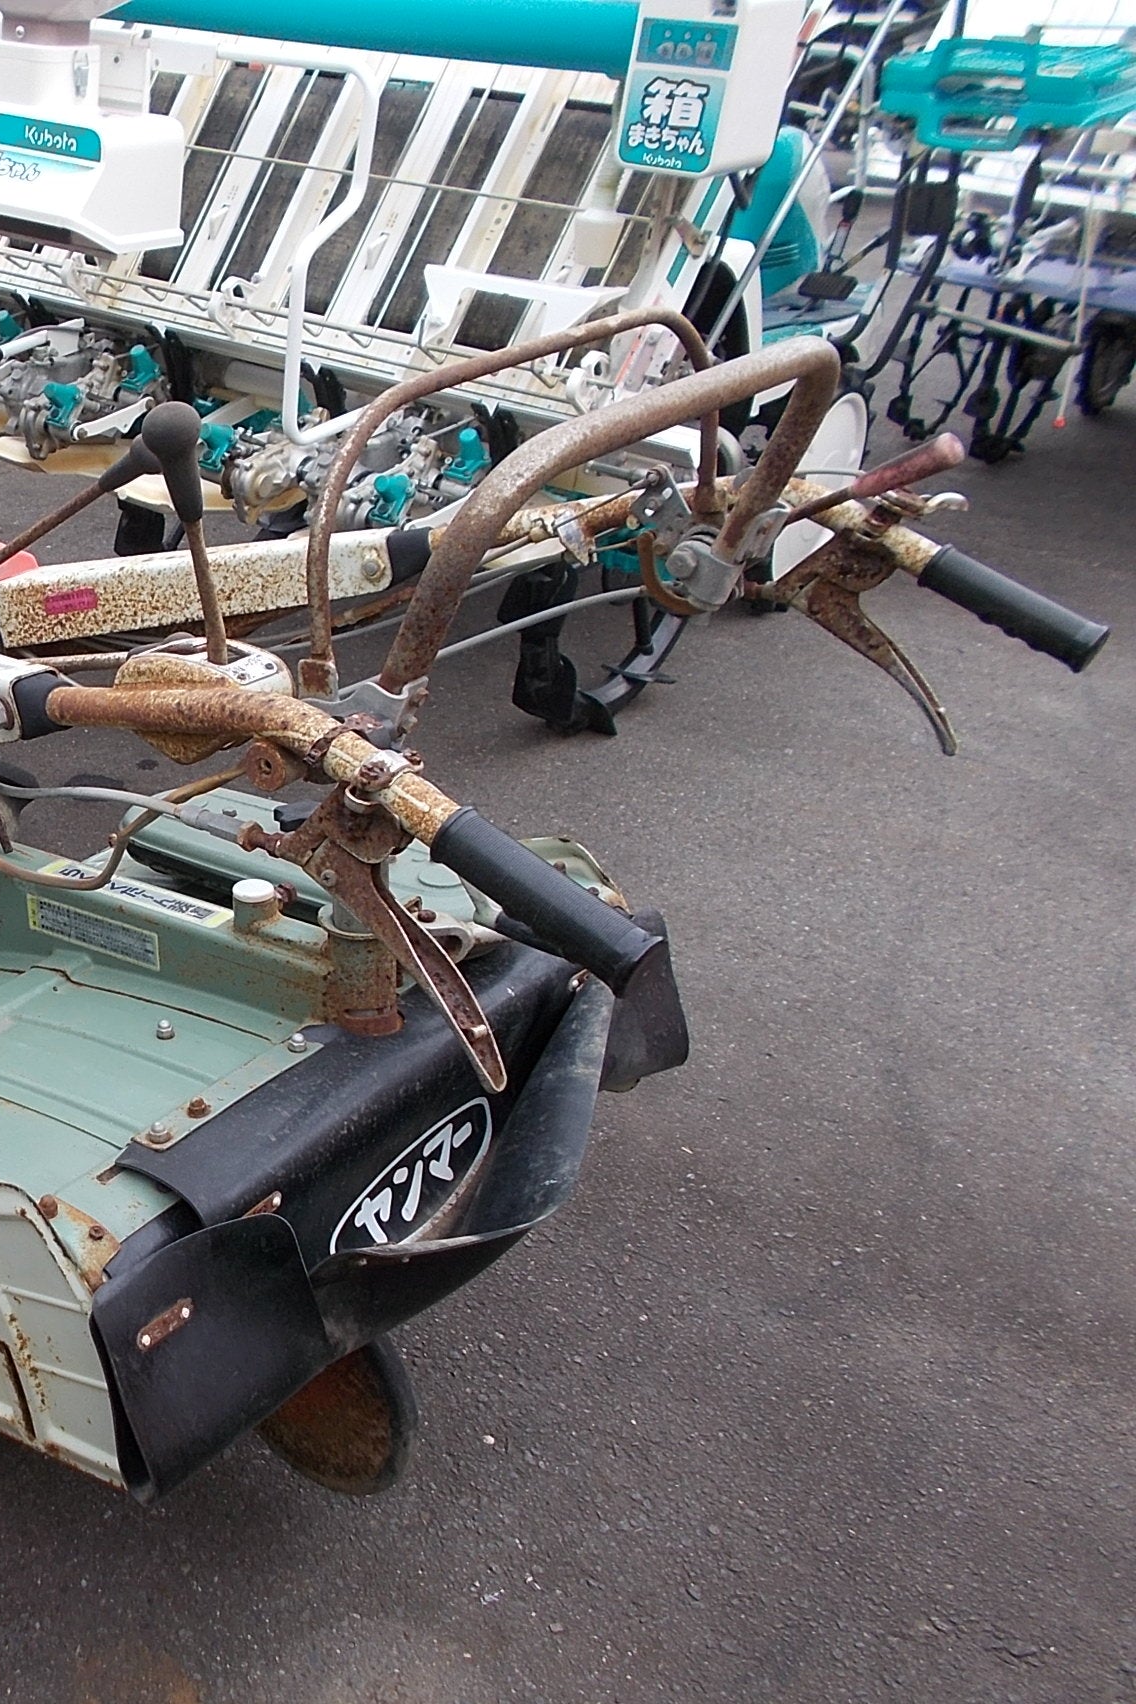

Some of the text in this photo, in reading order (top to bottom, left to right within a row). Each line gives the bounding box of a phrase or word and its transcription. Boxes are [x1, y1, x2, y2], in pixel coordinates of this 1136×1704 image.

[641, 76, 710, 128] 箱
[24, 124, 78, 152] Kubota
[628, 122, 705, 156] まきちゃん
[643, 152, 682, 169] Kubota
[354, 1121, 473, 1245] ヤンマー
